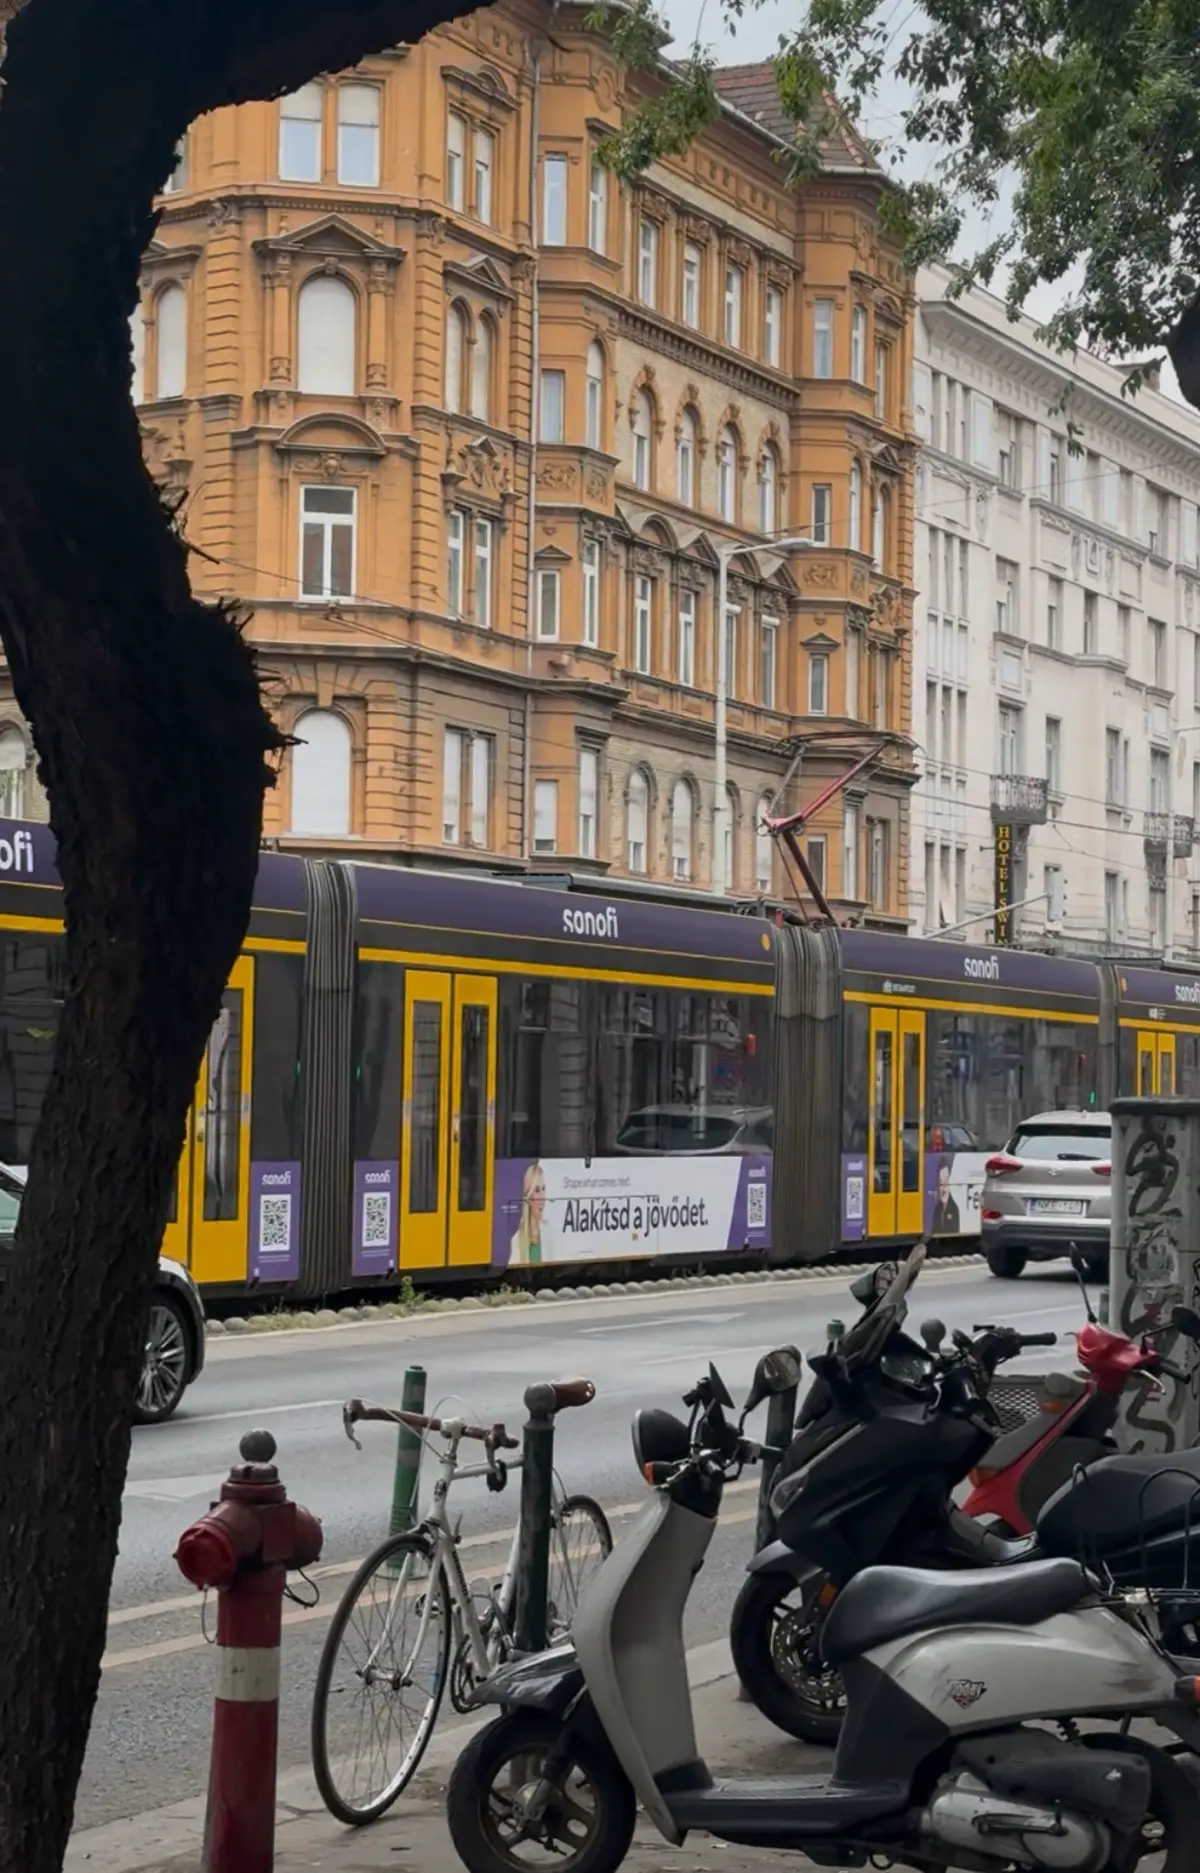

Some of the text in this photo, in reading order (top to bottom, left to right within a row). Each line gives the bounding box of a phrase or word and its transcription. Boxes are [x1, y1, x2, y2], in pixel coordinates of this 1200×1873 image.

[998, 826, 1011, 893] HOTEL
[563, 906, 619, 939] sanofi
[964, 955, 999, 980] sanofi
[262, 1170, 292, 1185] sanofi
[966, 1184, 985, 1210] Fe
[562, 1195, 709, 1238] Alakítsd a jövődet.
